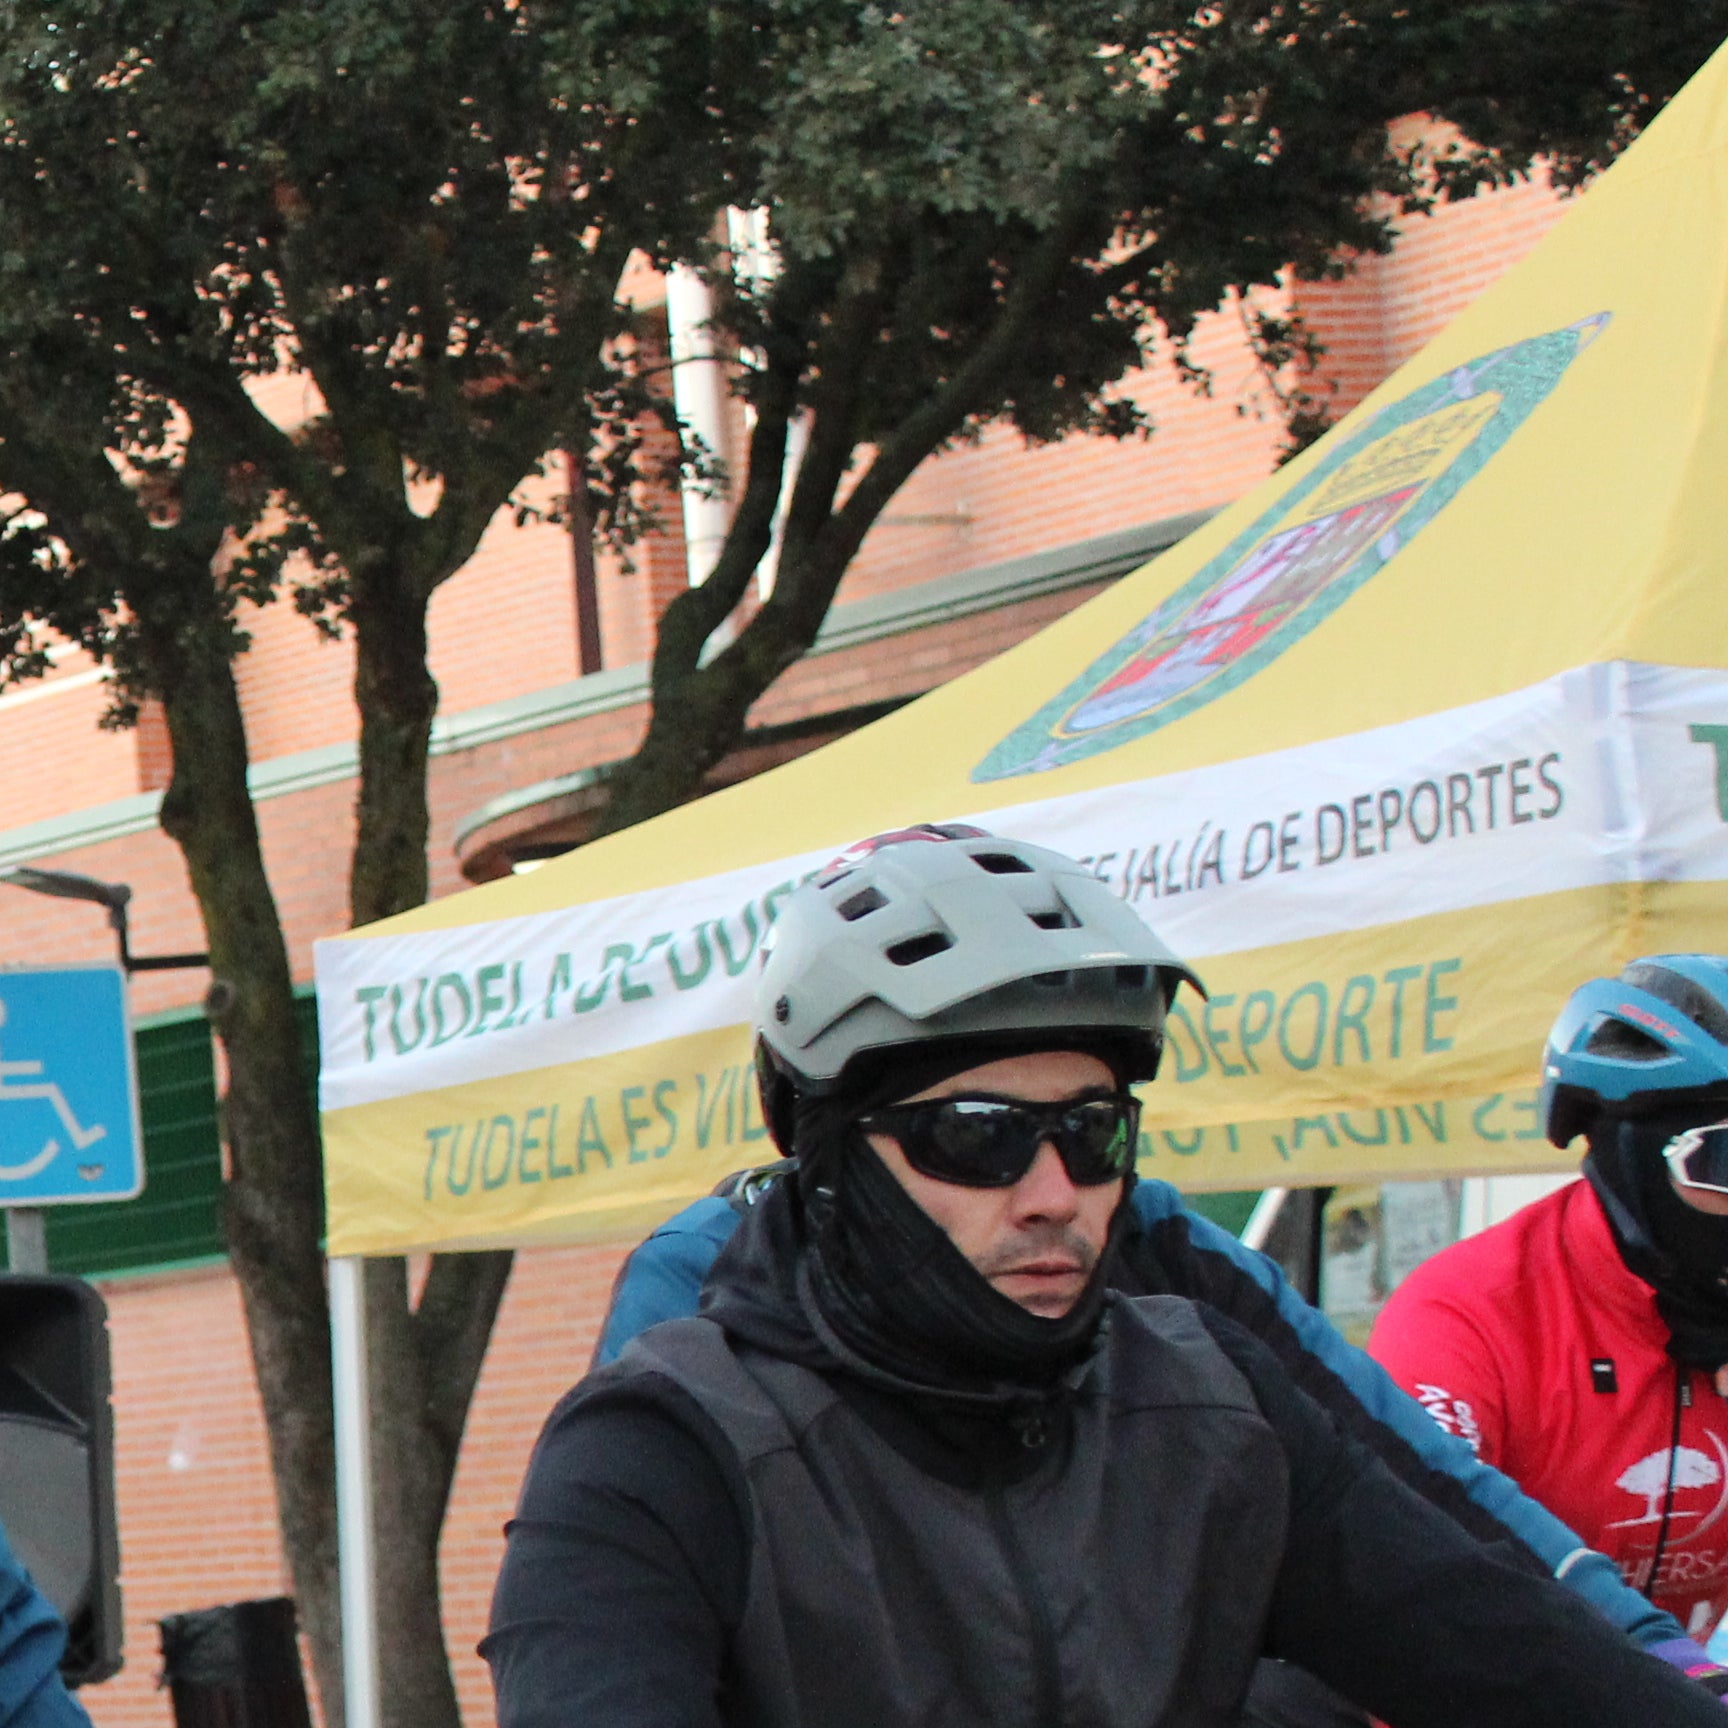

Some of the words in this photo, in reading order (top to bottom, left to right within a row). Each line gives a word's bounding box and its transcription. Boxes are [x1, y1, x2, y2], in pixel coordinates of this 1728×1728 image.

[1079, 819, 1223, 902] EJALÍA
[1240, 810, 1302, 881] DE
[1315, 752, 1563, 867] DEPORTES
[356, 952, 574, 1062] TUDELA
[424, 1096, 614, 1200] TUDELA
[621, 1078, 679, 1164] ES
[1166, 959, 1462, 1083] DEPORTE
